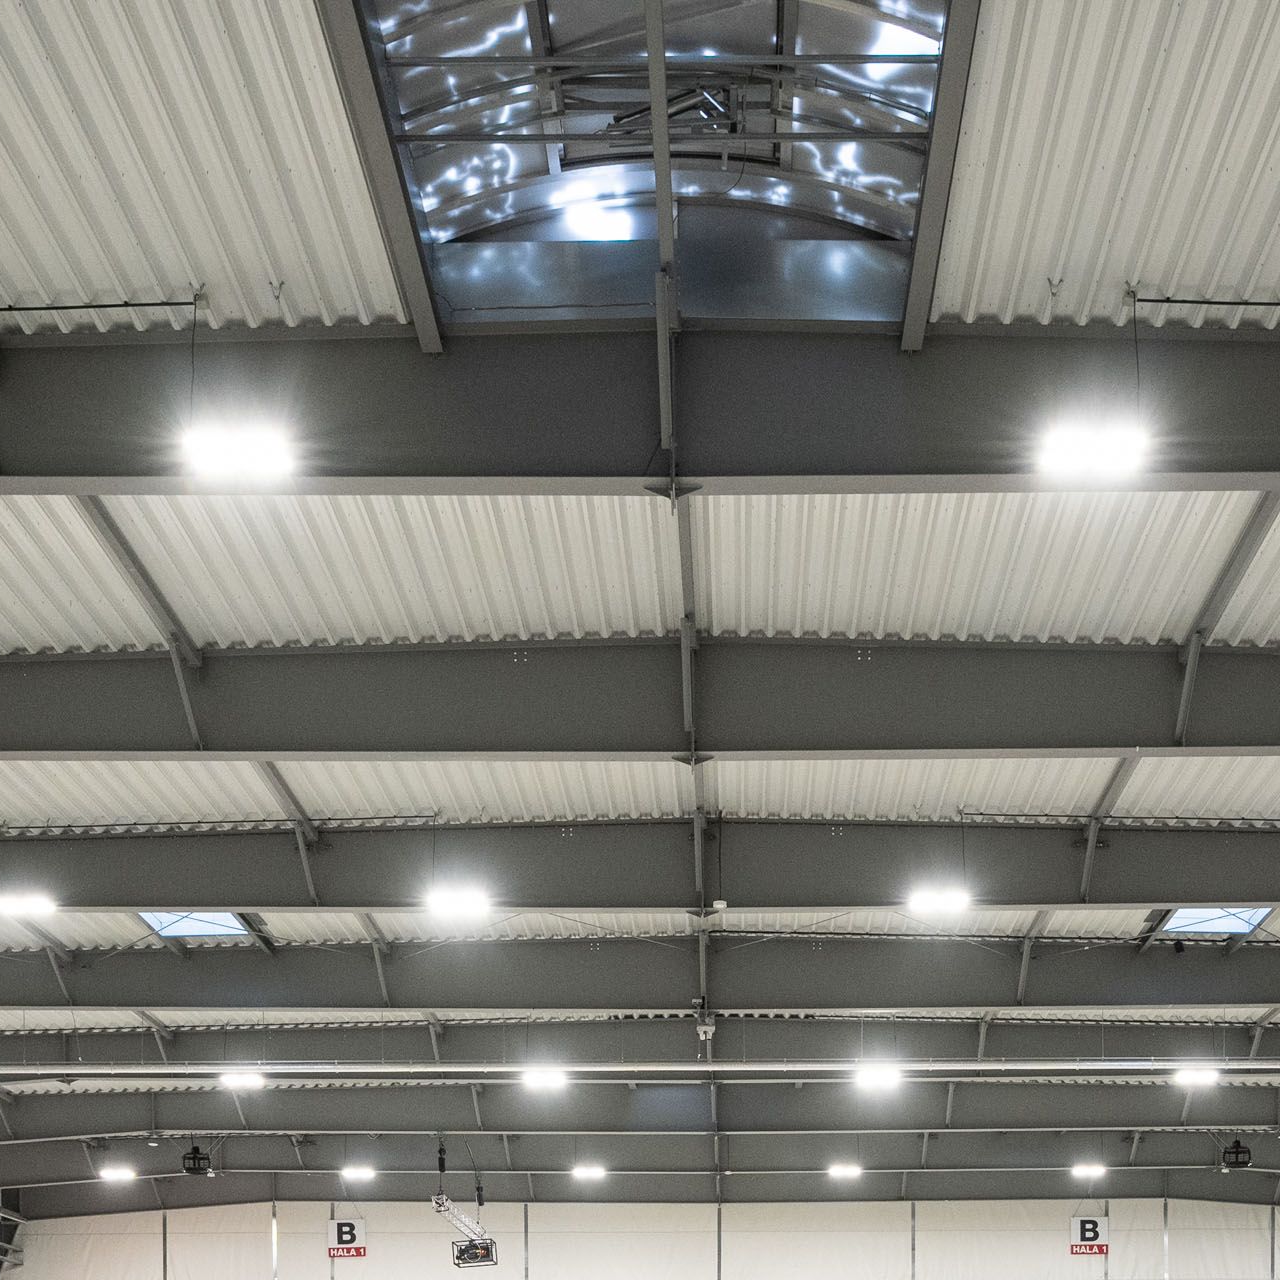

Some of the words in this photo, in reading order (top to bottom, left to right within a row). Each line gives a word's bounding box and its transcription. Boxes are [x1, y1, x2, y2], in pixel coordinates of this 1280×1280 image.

[337, 1223, 356, 1244] B
[1080, 1220, 1099, 1242] B
[329, 1248, 357, 1257] HALA
[359, 1248, 365, 1256] 1
[1072, 1245, 1099, 1254] HALA
[1102, 1245, 1108, 1253] 1
